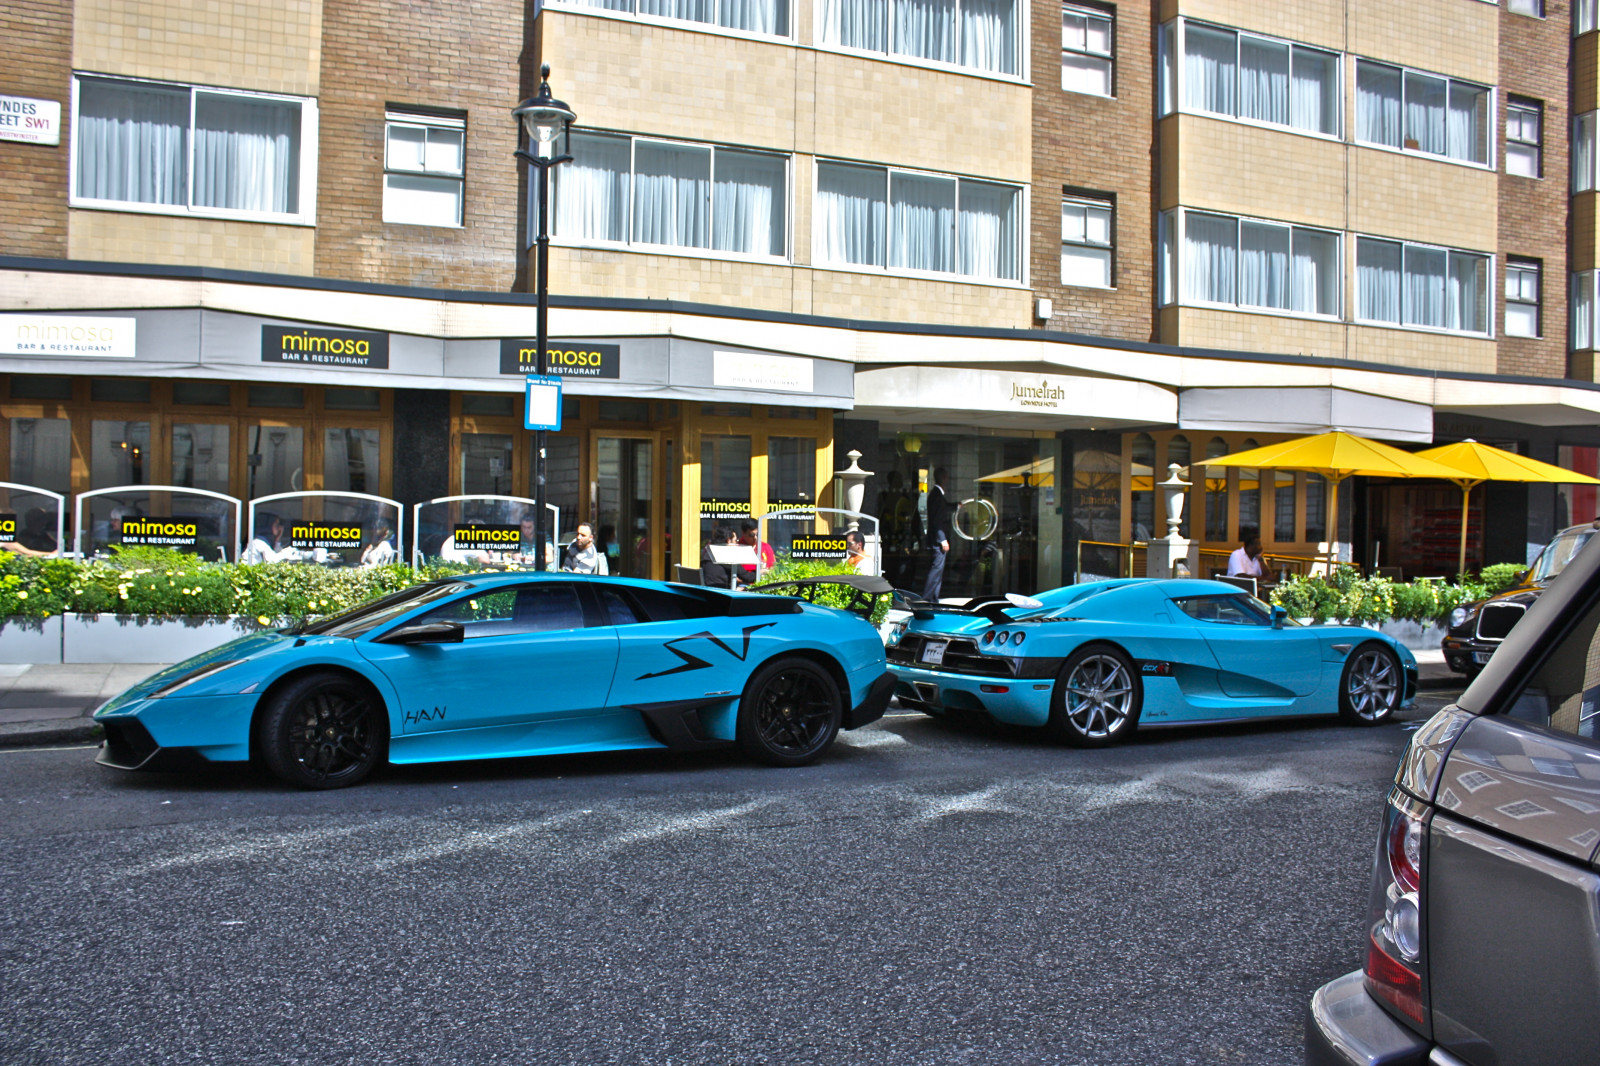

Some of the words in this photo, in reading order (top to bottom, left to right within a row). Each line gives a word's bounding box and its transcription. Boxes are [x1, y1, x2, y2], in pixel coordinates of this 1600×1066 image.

[0, 100, 37, 115] NDES
[25, 116, 50, 130] SW1
[17, 320, 113, 342] mimosa
[50, 344, 112, 352] RESTAURANT
[282, 330, 370, 356] mimosa
[282, 352, 300, 361] BAR
[303, 354, 309, 362] &
[312, 354, 369, 365] RESTAURANT
[519, 348, 601, 367] mmosa
[519, 365, 536, 373] BAR
[547, 366, 601, 376] RESTAURANT
[1010, 380, 1065, 400] Jumeirah
[700, 498, 751, 512] mimosa
[123, 517, 197, 536] mimosa
[292, 522, 361, 540] mimosa
[455, 525, 520, 542] mimosa
[147, 537, 196, 545] RESTAURANT
[792, 535, 847, 550] mimosa
[404, 705, 447, 725] HAN
